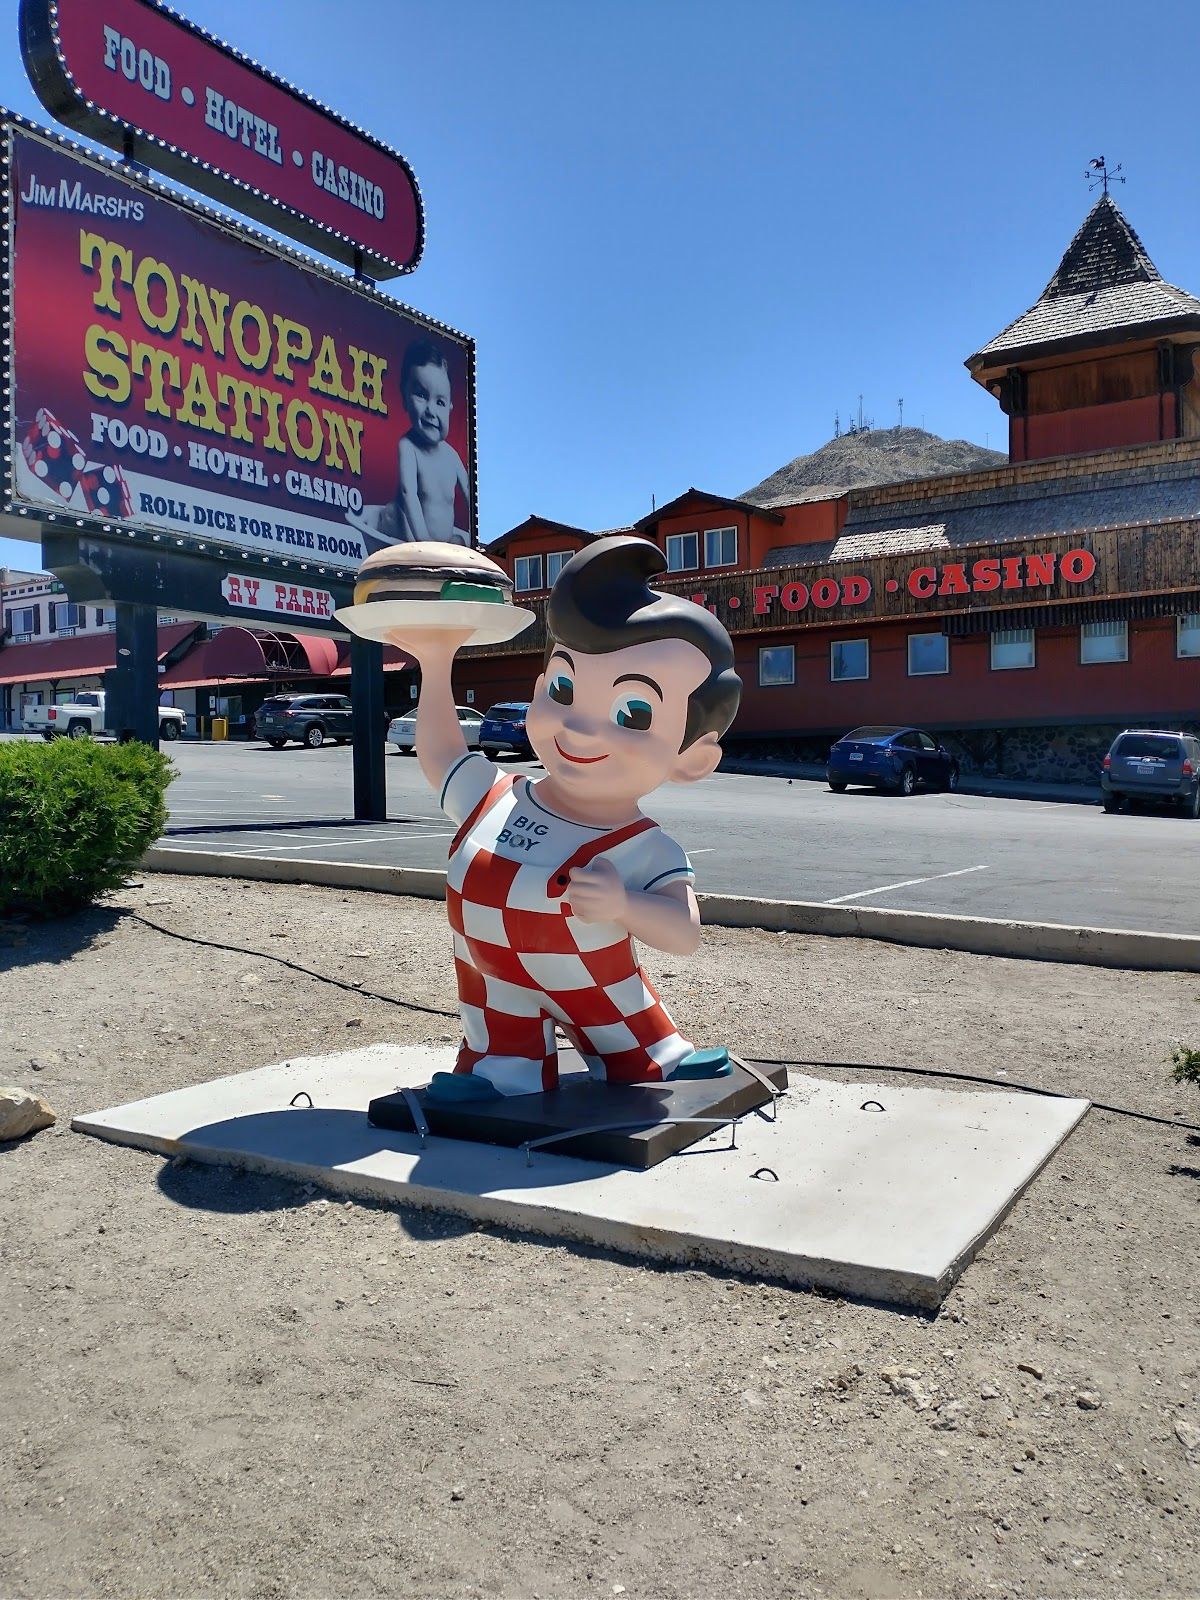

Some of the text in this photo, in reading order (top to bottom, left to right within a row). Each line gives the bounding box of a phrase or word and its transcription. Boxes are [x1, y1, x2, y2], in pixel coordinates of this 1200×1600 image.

[103, 24, 385, 220] FOOD HOTEL CASINO
[21, 175, 144, 221] JIM MARSH'S
[79, 229, 389, 415] TONOPAH
[82, 324, 364, 475] STATION
[91, 412, 363, 513] FOOD HOTEL CASINO
[139, 492, 363, 560] ROLL DICE FOR FREE ROOM
[227, 576, 331, 617] RV PARK
[753, 576, 872, 615] FOOD
[908, 549, 1097, 598] CASINO
[495, 828, 541, 851] BOY
[513, 815, 549, 836] BIG
